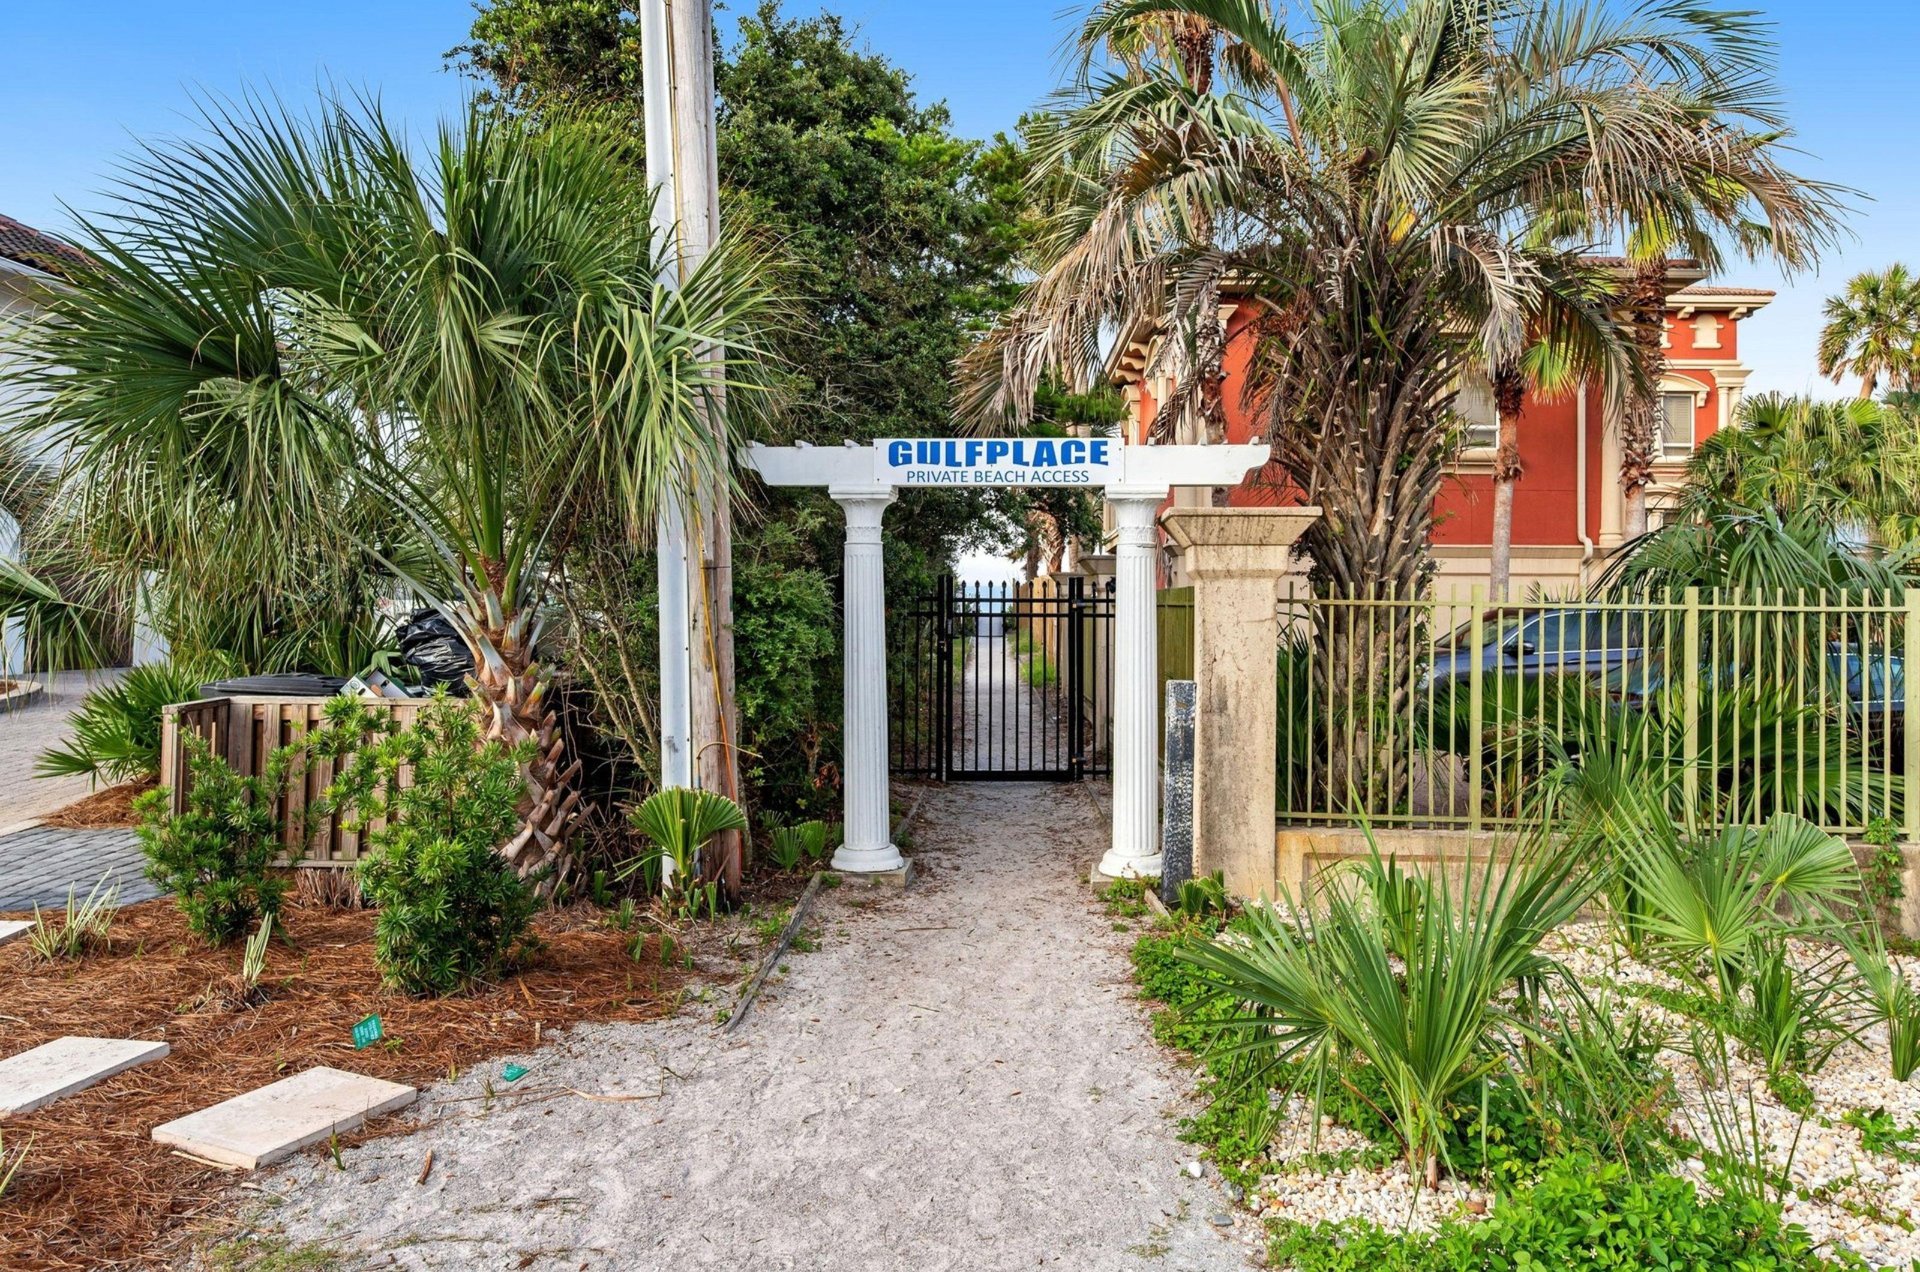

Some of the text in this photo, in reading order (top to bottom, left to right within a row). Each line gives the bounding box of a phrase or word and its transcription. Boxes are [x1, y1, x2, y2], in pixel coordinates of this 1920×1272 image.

[888, 440, 1108, 467] GULFPLACE
[907, 470, 1089, 483] PRIVATE BEACH ACCESS
